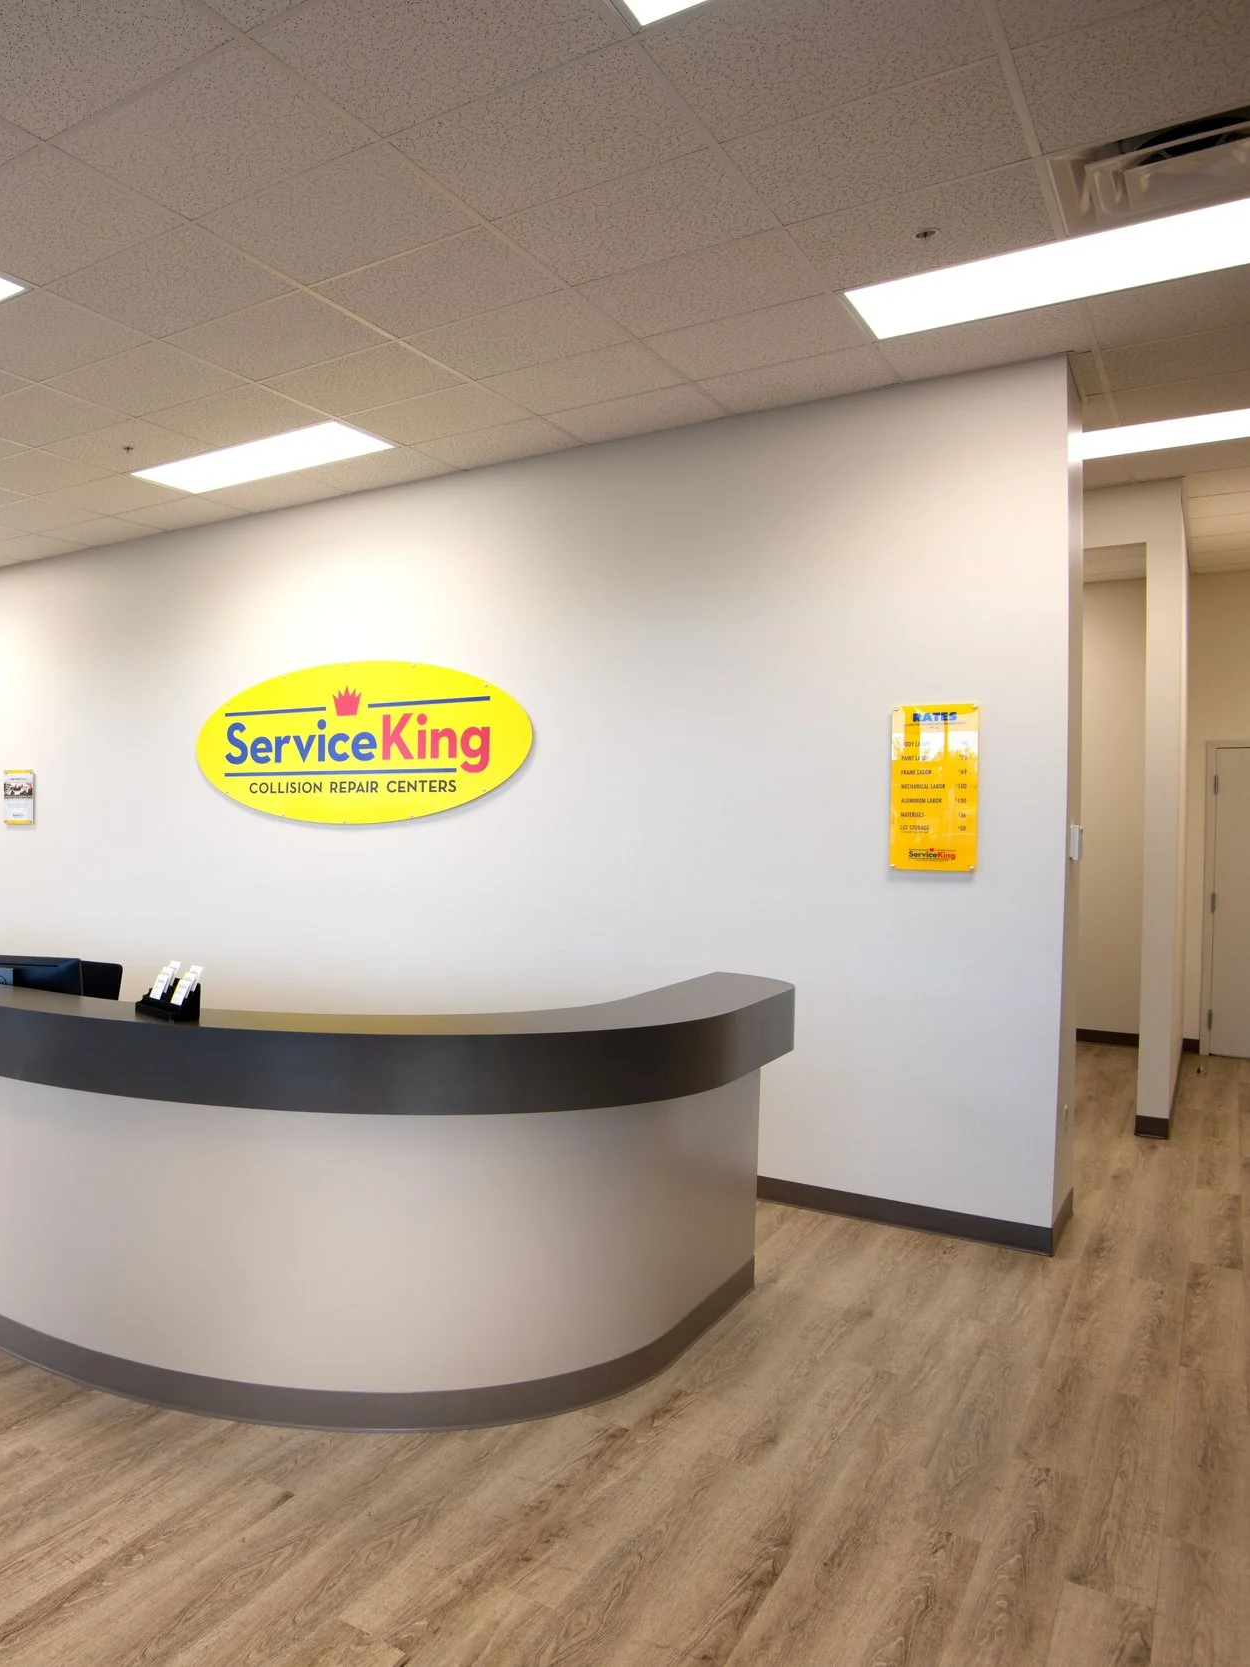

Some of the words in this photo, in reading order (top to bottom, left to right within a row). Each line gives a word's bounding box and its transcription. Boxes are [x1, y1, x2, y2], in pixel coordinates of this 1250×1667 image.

[912, 712, 958, 722] RATES
[225, 712, 491, 774] ServiceKing
[249, 782, 323, 794] COLLISION
[329, 780, 379, 793] REPAIR
[386, 779, 457, 793] CENTERS
[908, 850, 956, 860] ServiceKing
